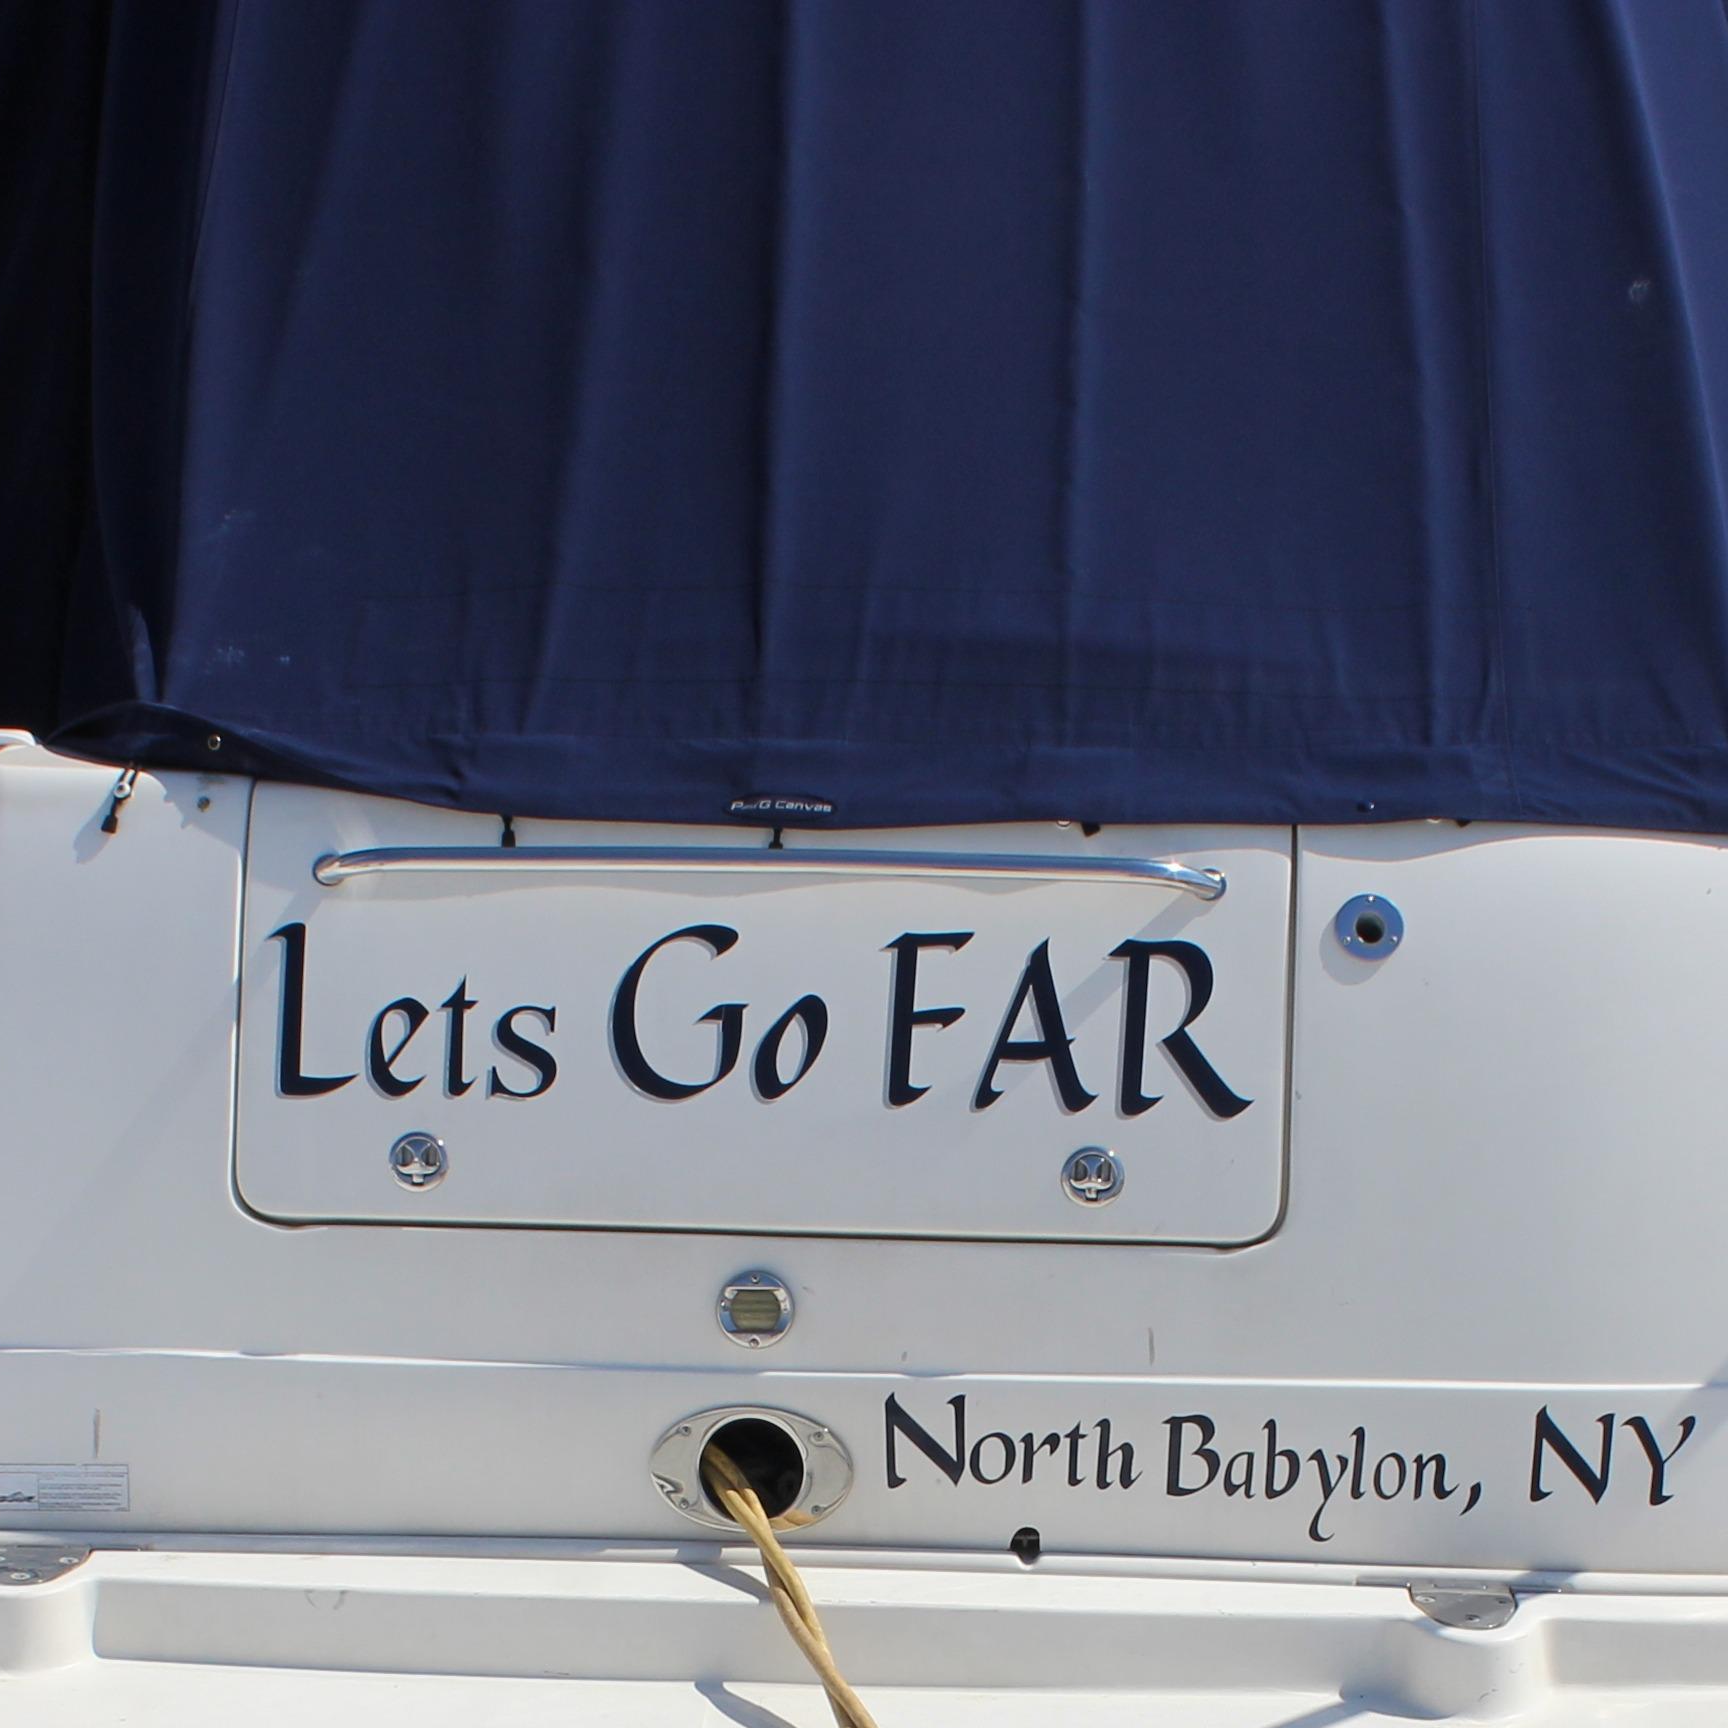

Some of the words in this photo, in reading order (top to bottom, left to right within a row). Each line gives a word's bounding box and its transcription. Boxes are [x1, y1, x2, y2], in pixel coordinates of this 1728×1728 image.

[775, 800, 832, 812] Canvas
[268, 921, 559, 1102] Lets
[611, 922, 831, 1103] Go
[884, 930, 1254, 1121] FAR
[883, 1392, 1143, 1490] North
[1164, 1414, 1482, 1542] Babylon,
[1528, 1404, 1696, 1507] NY
